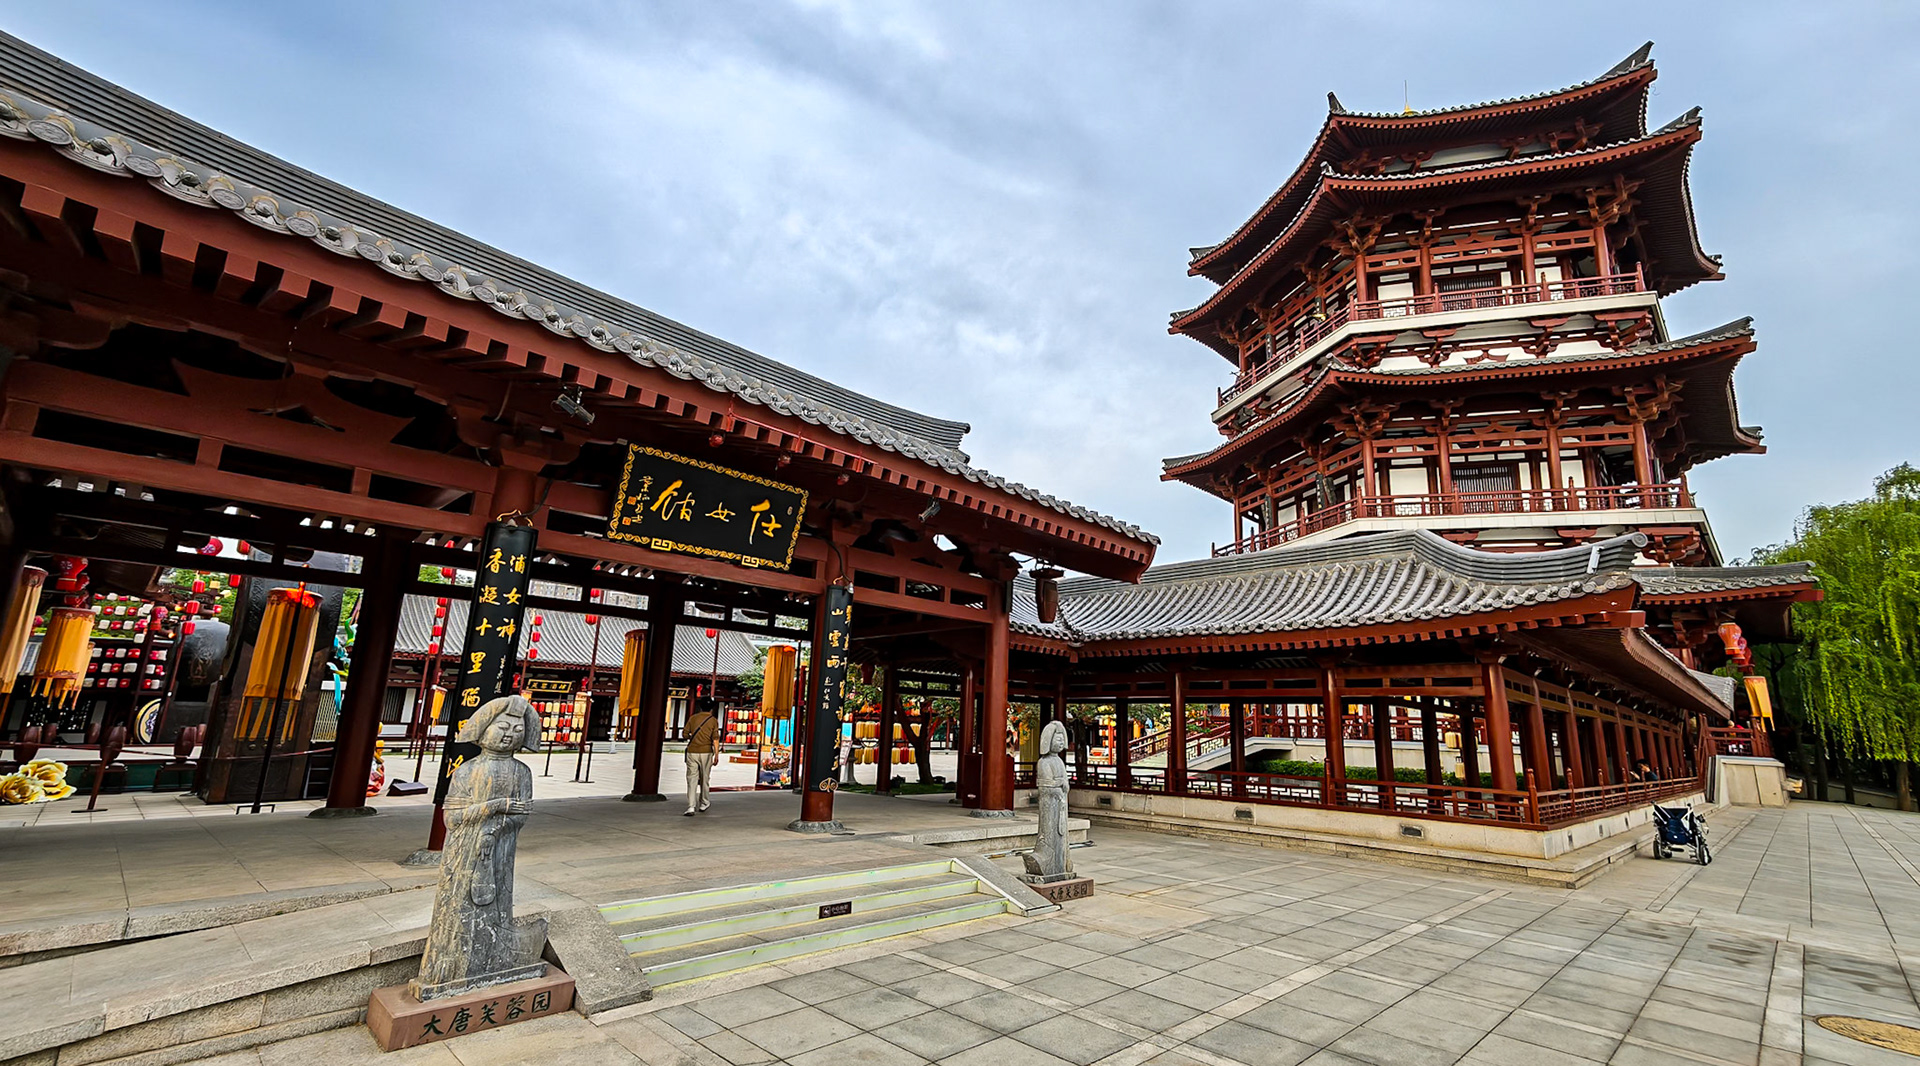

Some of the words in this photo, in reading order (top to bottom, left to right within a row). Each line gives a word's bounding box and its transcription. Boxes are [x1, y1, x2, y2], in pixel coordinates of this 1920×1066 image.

[1049, 883, 1088, 900] 大唐芙蓉园
[419, 990, 552, 1040] 大唐芙蓉园
